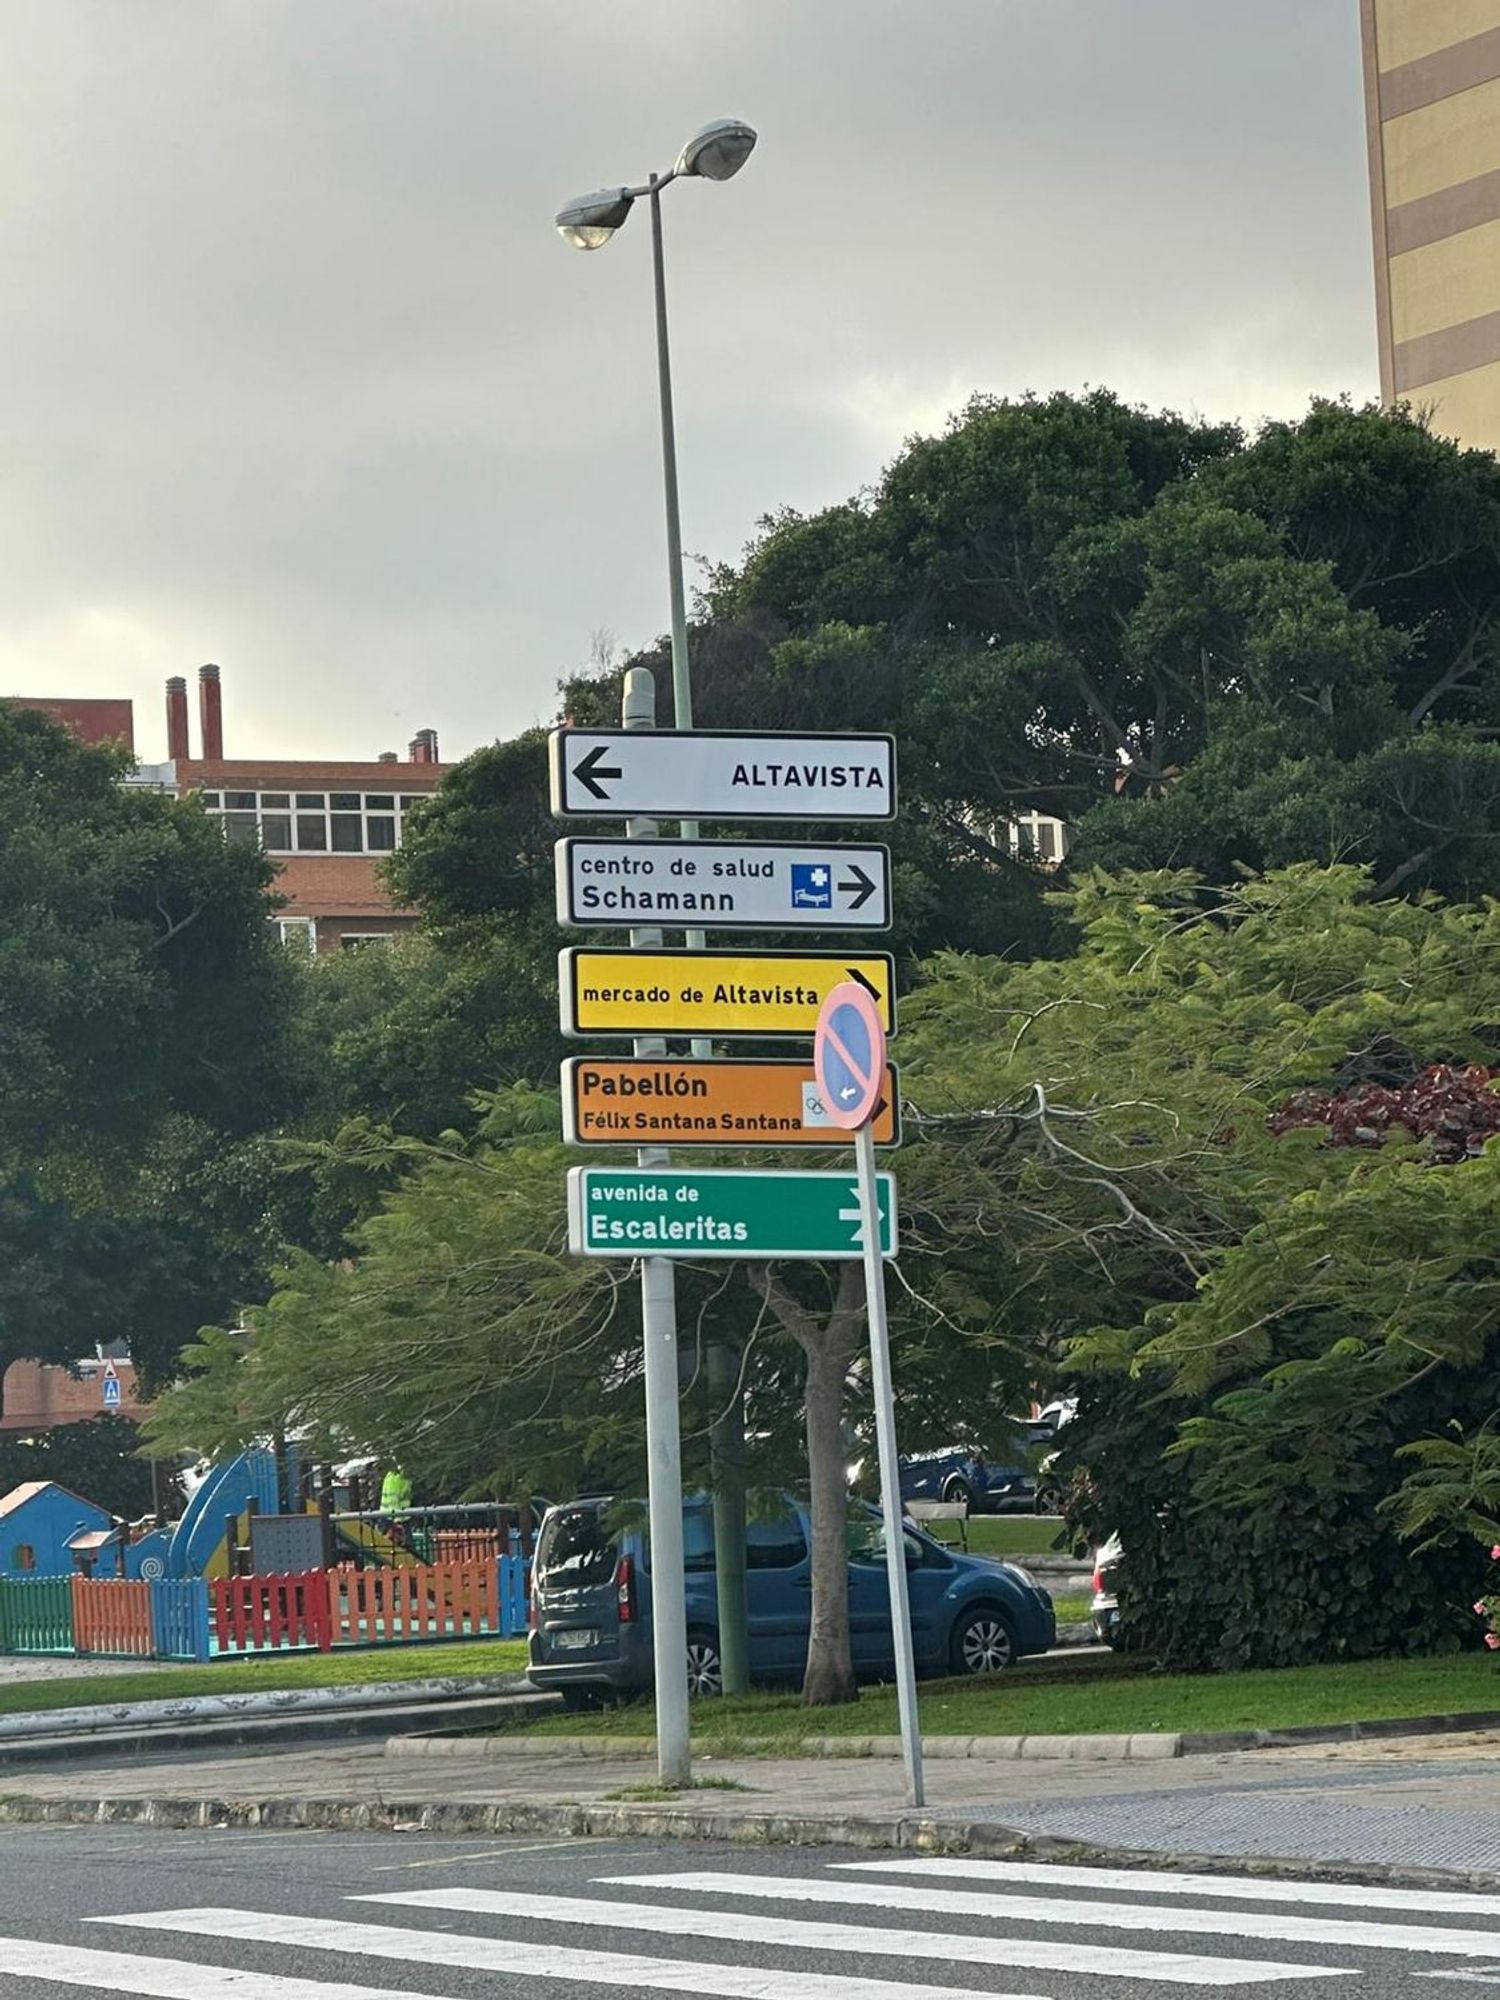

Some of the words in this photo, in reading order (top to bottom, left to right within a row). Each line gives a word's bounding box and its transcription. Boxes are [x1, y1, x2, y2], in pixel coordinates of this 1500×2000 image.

[732, 764, 884, 788] ALTAVISTA
[581, 856, 654, 875] centro
[670, 858, 696, 876] de
[712, 860, 774, 878] salud
[582, 886, 734, 911] Schamann
[583, 985, 670, 1003] mercado
[680, 987, 704, 1004] de
[713, 985, 819, 1005] Altavista
[583, 1071, 708, 1097] Pabellón
[583, 1112, 630, 1129] Félix
[635, 1113, 717, 1130] Santana
[721, 1114, 802, 1130] Santana
[591, 1184, 668, 1202] avenida
[675, 1185, 699, 1202] de
[591, 1215, 748, 1241] Escaleritas
